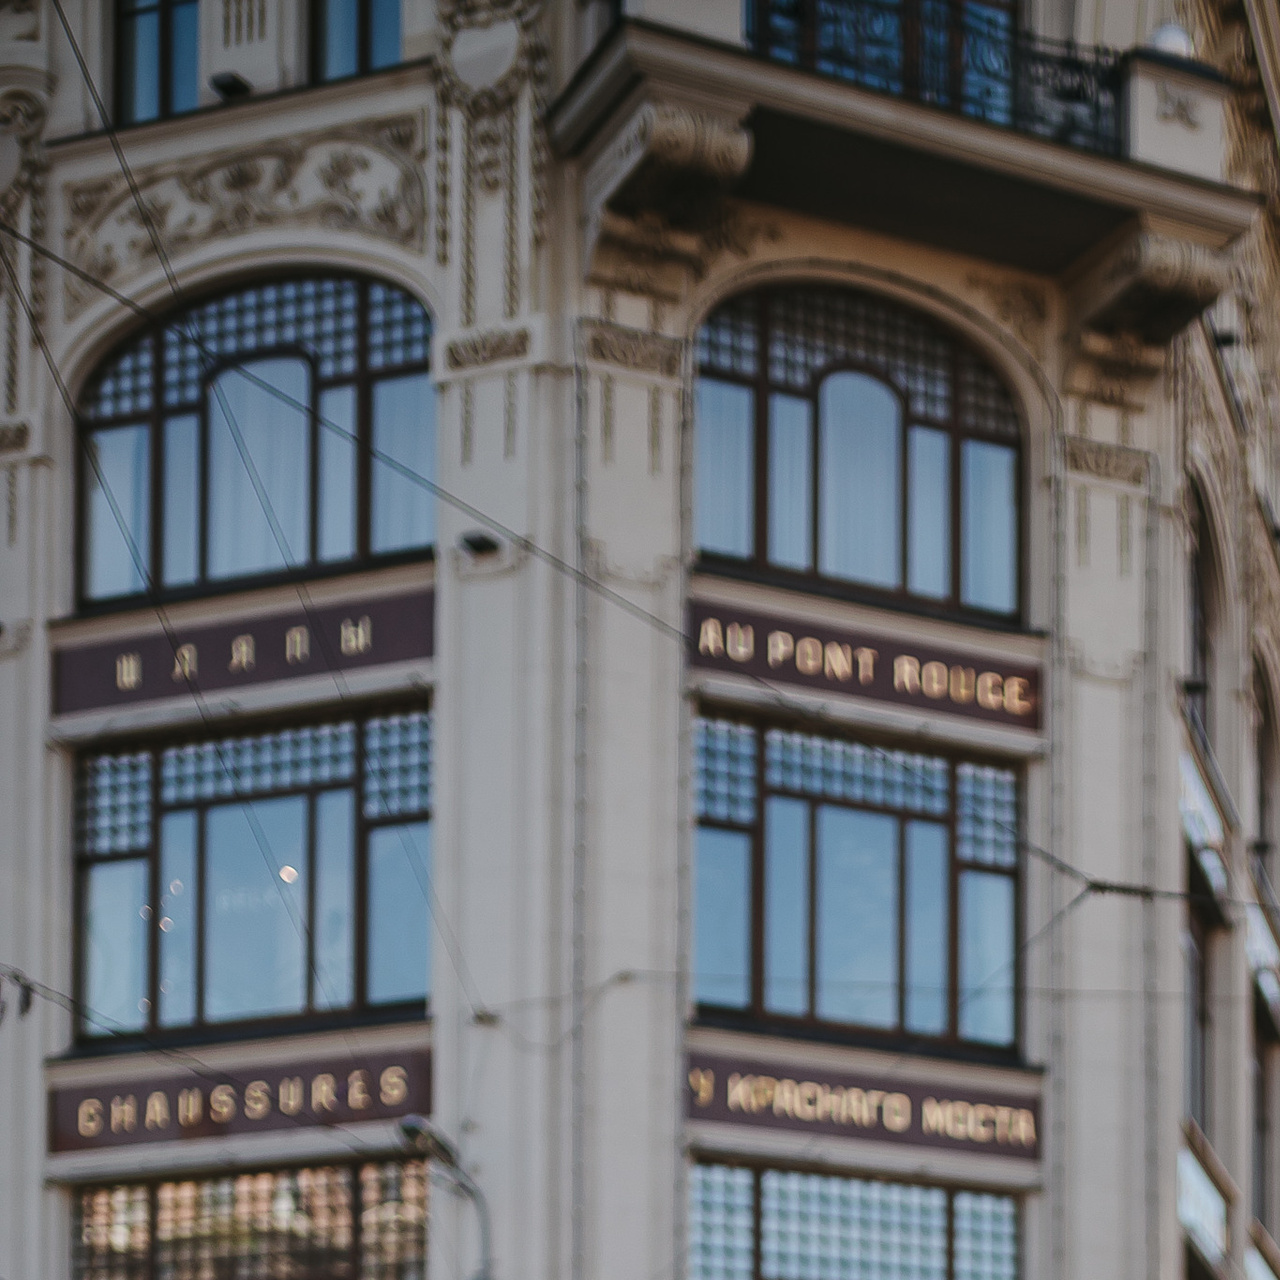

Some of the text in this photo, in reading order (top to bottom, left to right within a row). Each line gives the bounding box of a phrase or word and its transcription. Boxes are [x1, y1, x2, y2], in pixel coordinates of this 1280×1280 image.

[699, 617, 1034, 716] AU PONT ROUGE
[77, 1065, 408, 1138] CHAUSSURES
[727, 1072, 912, 1133] КРАСНАГО
[922, 1096, 1036, 1148] МОСТА
